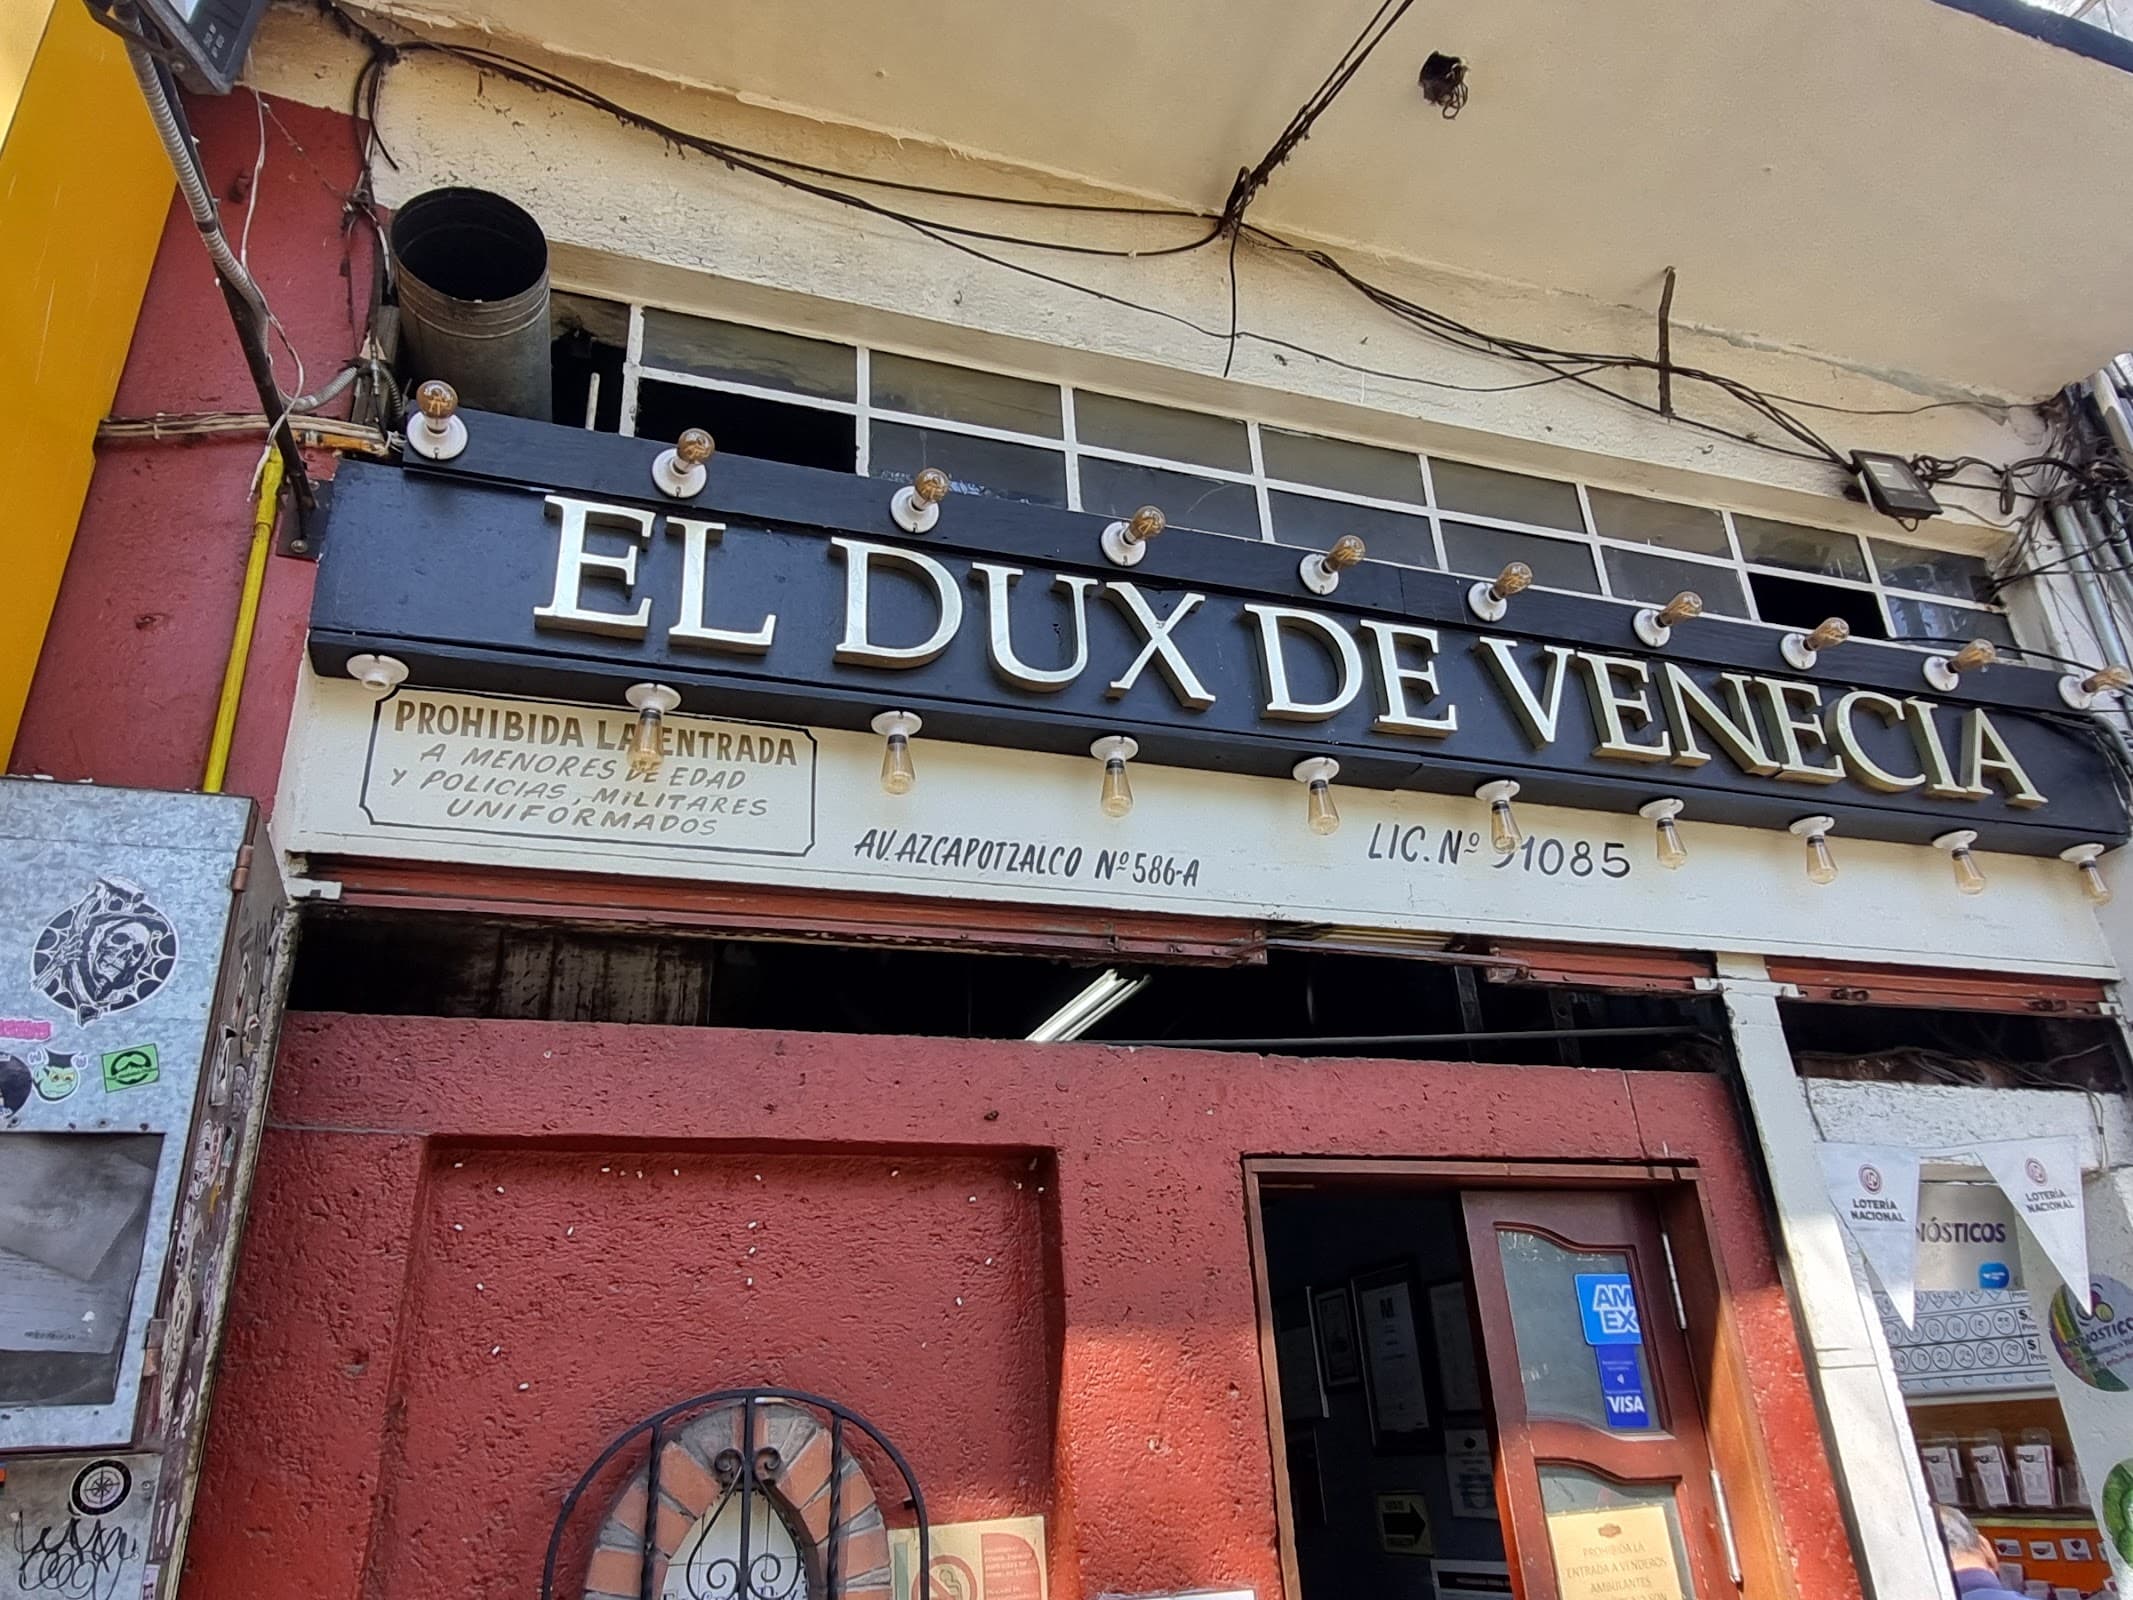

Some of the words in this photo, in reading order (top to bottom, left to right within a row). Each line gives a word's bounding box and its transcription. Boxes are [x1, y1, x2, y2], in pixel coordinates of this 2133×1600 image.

[533, 494, 776, 656] EL
[828, 536, 1216, 711] DUX
[1243, 603, 1458, 739] DE
[1478, 636, 2049, 809] VENECIA
[394, 699, 584, 748] PROHIBIDA
[597, 720, 637, 750] LA
[660, 727, 797, 766] ENTRADA
[390, 768, 407, 786] Y
[420, 743, 446, 762] A
[461, 747, 617, 779] MENORES
[669, 766, 745, 790] EDAD
[446, 798, 718, 836] UNIFORMADOS
[1132, 852, 1200, 887] 586-A
[1851, 1211, 1906, 1222] NACIONAL
[1852, 1198, 1898, 1210] LOTERÍA
[2026, 1200, 2075, 1213] NACIONAL
[1606, 1396, 1645, 1413] VISA
